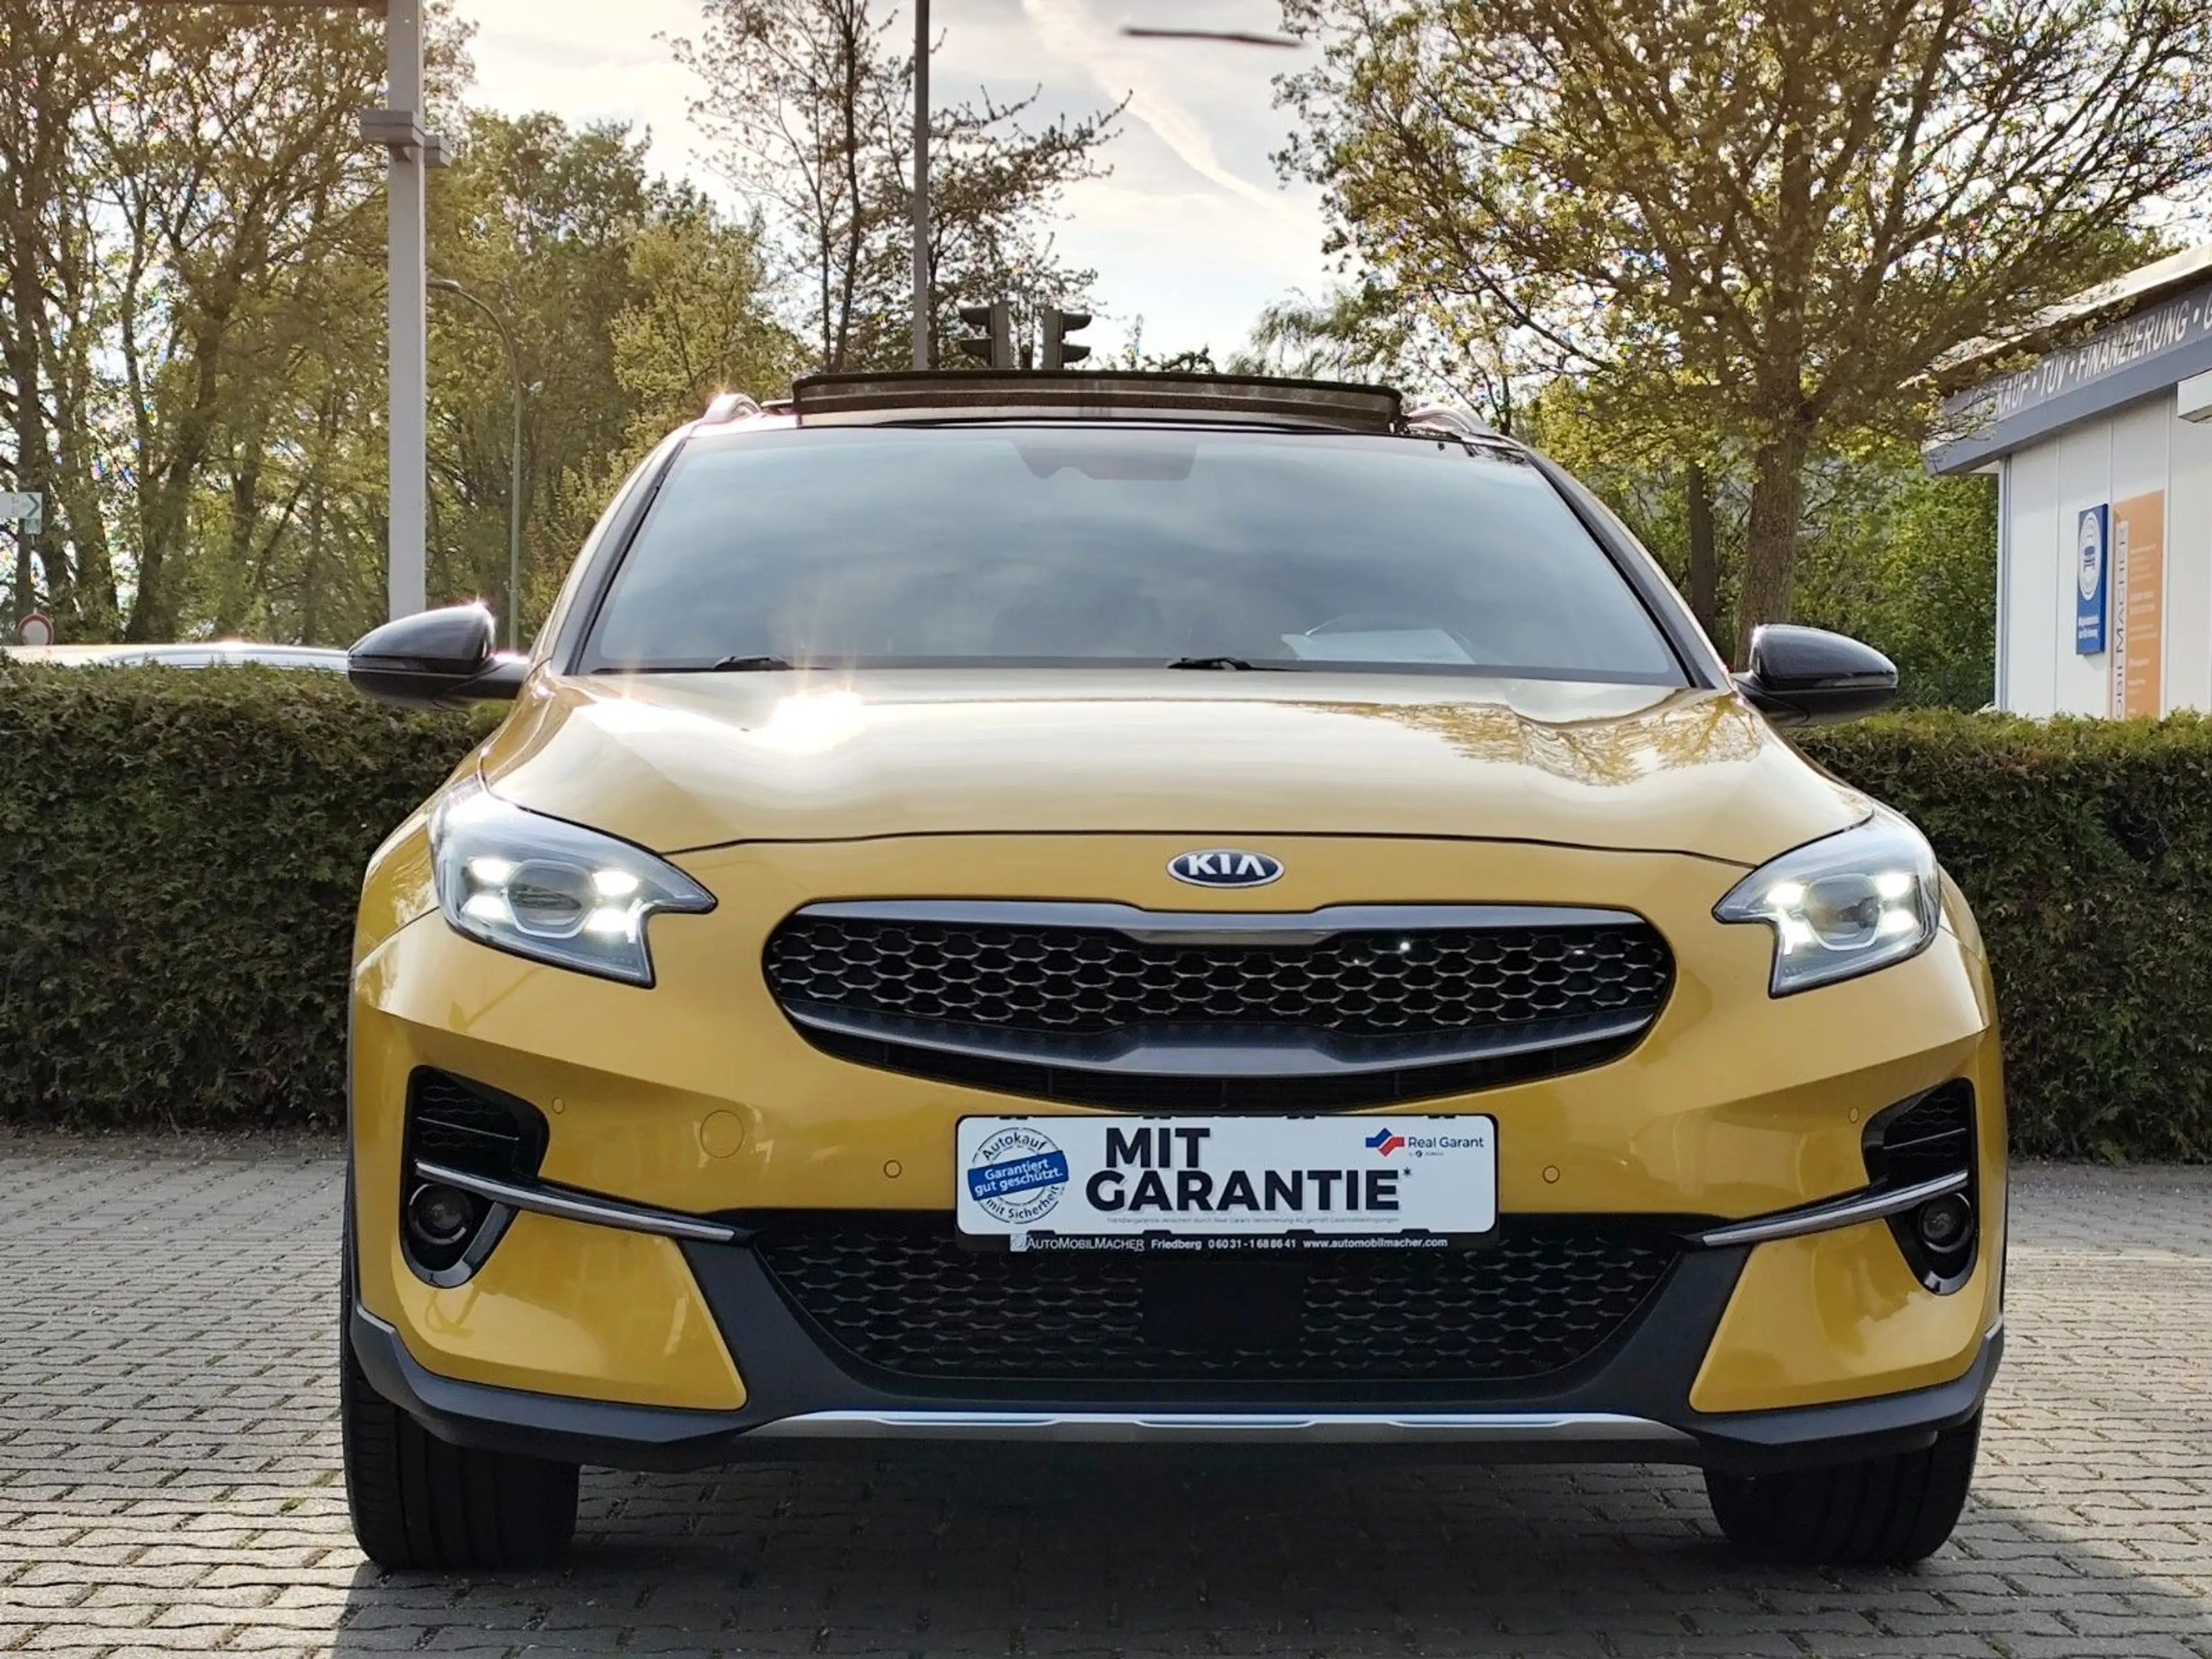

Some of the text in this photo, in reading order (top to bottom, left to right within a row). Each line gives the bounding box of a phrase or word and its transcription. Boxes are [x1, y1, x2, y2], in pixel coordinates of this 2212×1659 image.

[2076, 300, 2190, 382] FINANZIERUNG
[1188, 854, 1266, 876] KIA
[983, 1132, 1047, 1160] Autokauf
[1106, 1128, 1209, 1168] MIT
[1408, 1137, 1484, 1148] Real Garant
[984, 1159, 1048, 1180] Garantiert
[975, 1182, 997, 1197] gut
[986, 1186, 1060, 1219] mit Sicherheit
[1152, 1240, 1202, 1251] Friedberg
[1303, 1238, 1449, 1249] www.automobilmacher.com
